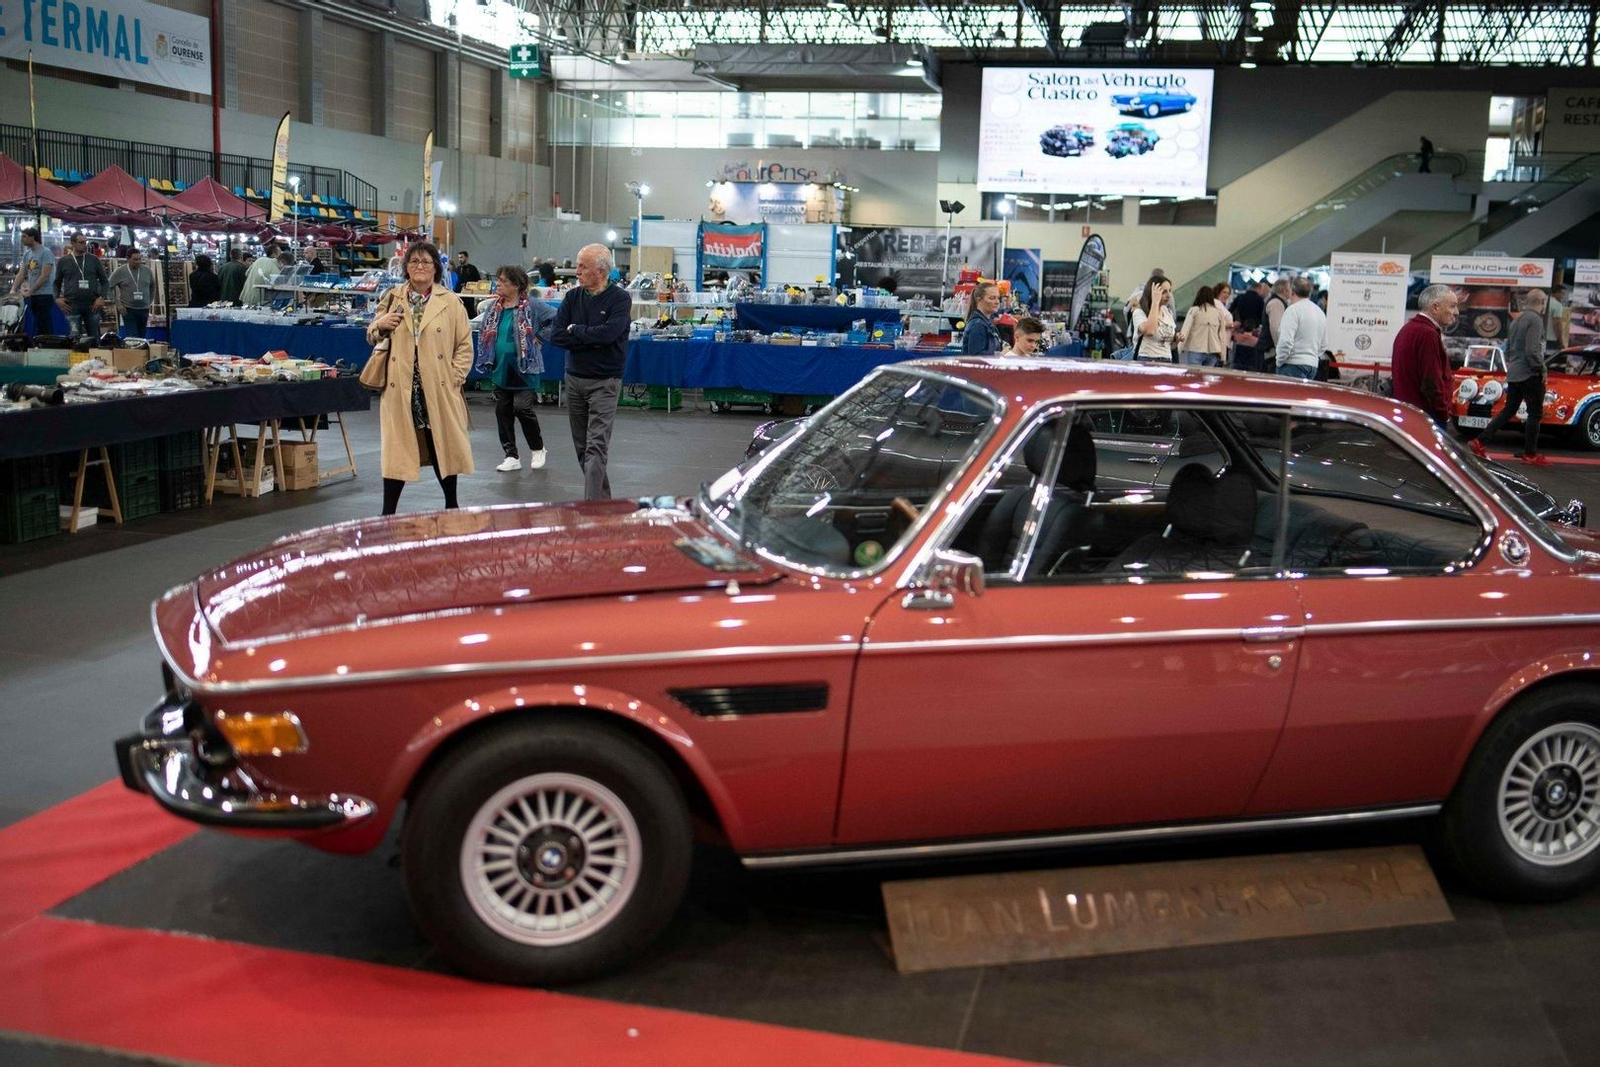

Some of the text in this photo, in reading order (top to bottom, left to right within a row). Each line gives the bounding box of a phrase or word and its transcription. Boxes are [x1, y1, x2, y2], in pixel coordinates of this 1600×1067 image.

[23, 0, 149, 65] TERMAL
[171, 45, 204, 61] OURENSE
[883, 234, 962, 254] REBECA
[1440, 263, 1518, 273] ALPINCHE
[1341, 316, 1354, 324] La
[1037, 875, 1328, 931] LUMBRERAS
